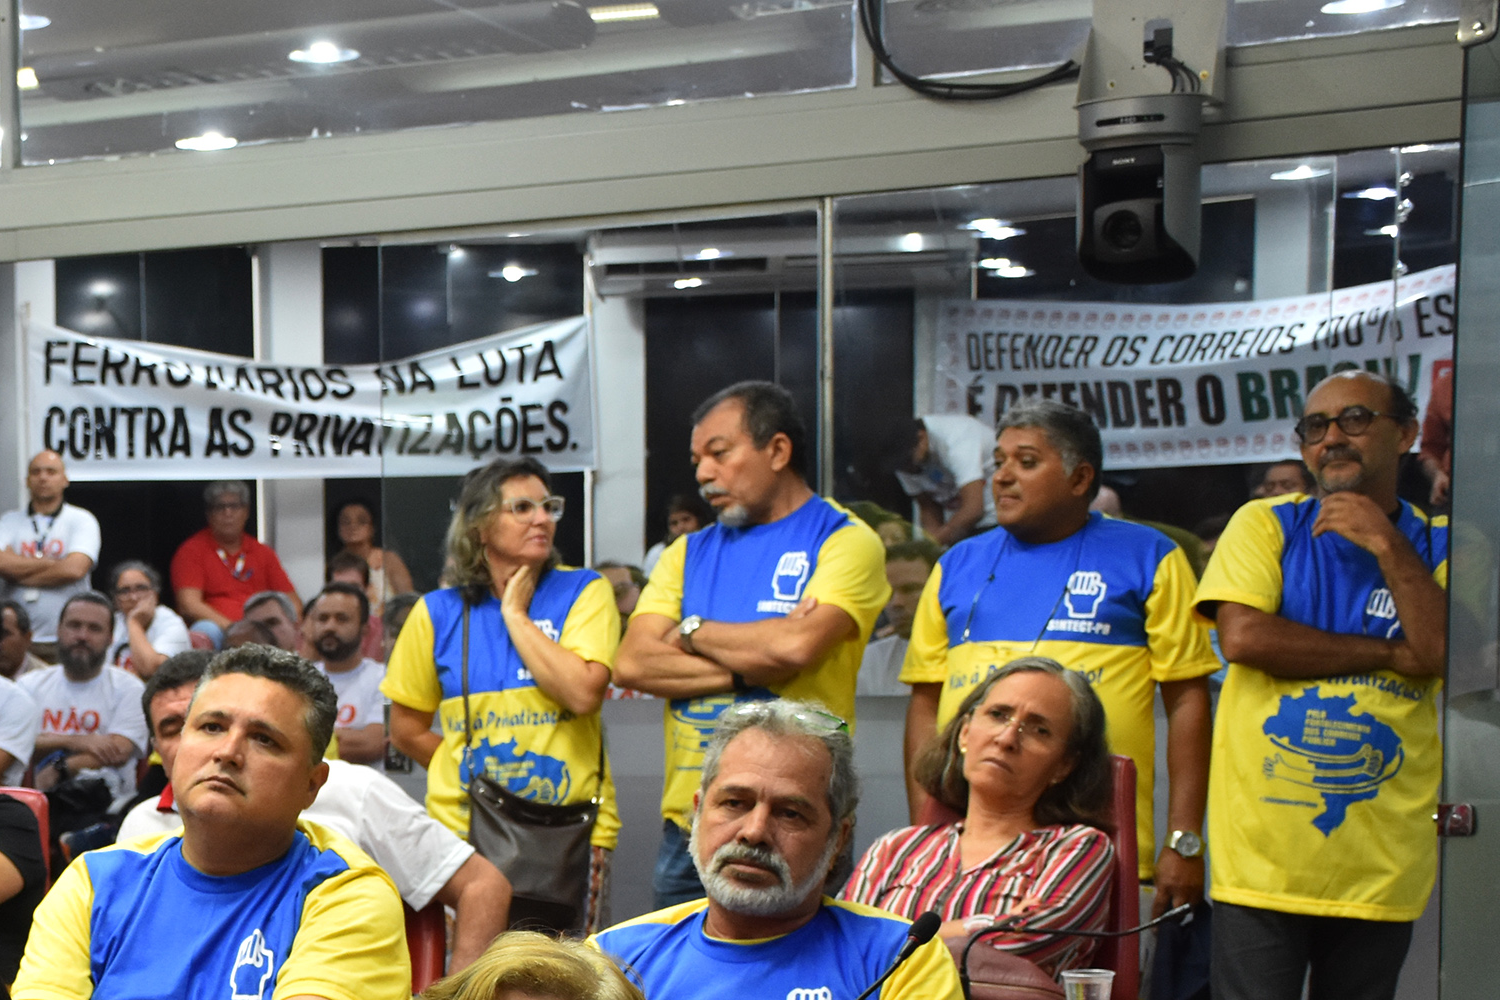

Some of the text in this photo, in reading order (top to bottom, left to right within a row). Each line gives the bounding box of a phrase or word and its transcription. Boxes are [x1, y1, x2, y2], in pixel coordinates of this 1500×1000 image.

[380, 365, 436, 394] NA
[448, 339, 564, 390] LUTA
[966, 331, 1098, 371] DEFENDER
[1102, 334, 1148, 368] OS
[1149, 322, 1305, 366] CORREIOS
[1196, 373, 1227, 426] O
[43, 396, 579, 461] CONTRA AS PRIVATIZAÇÕES.
[42, 705, 101, 734] NÃO
